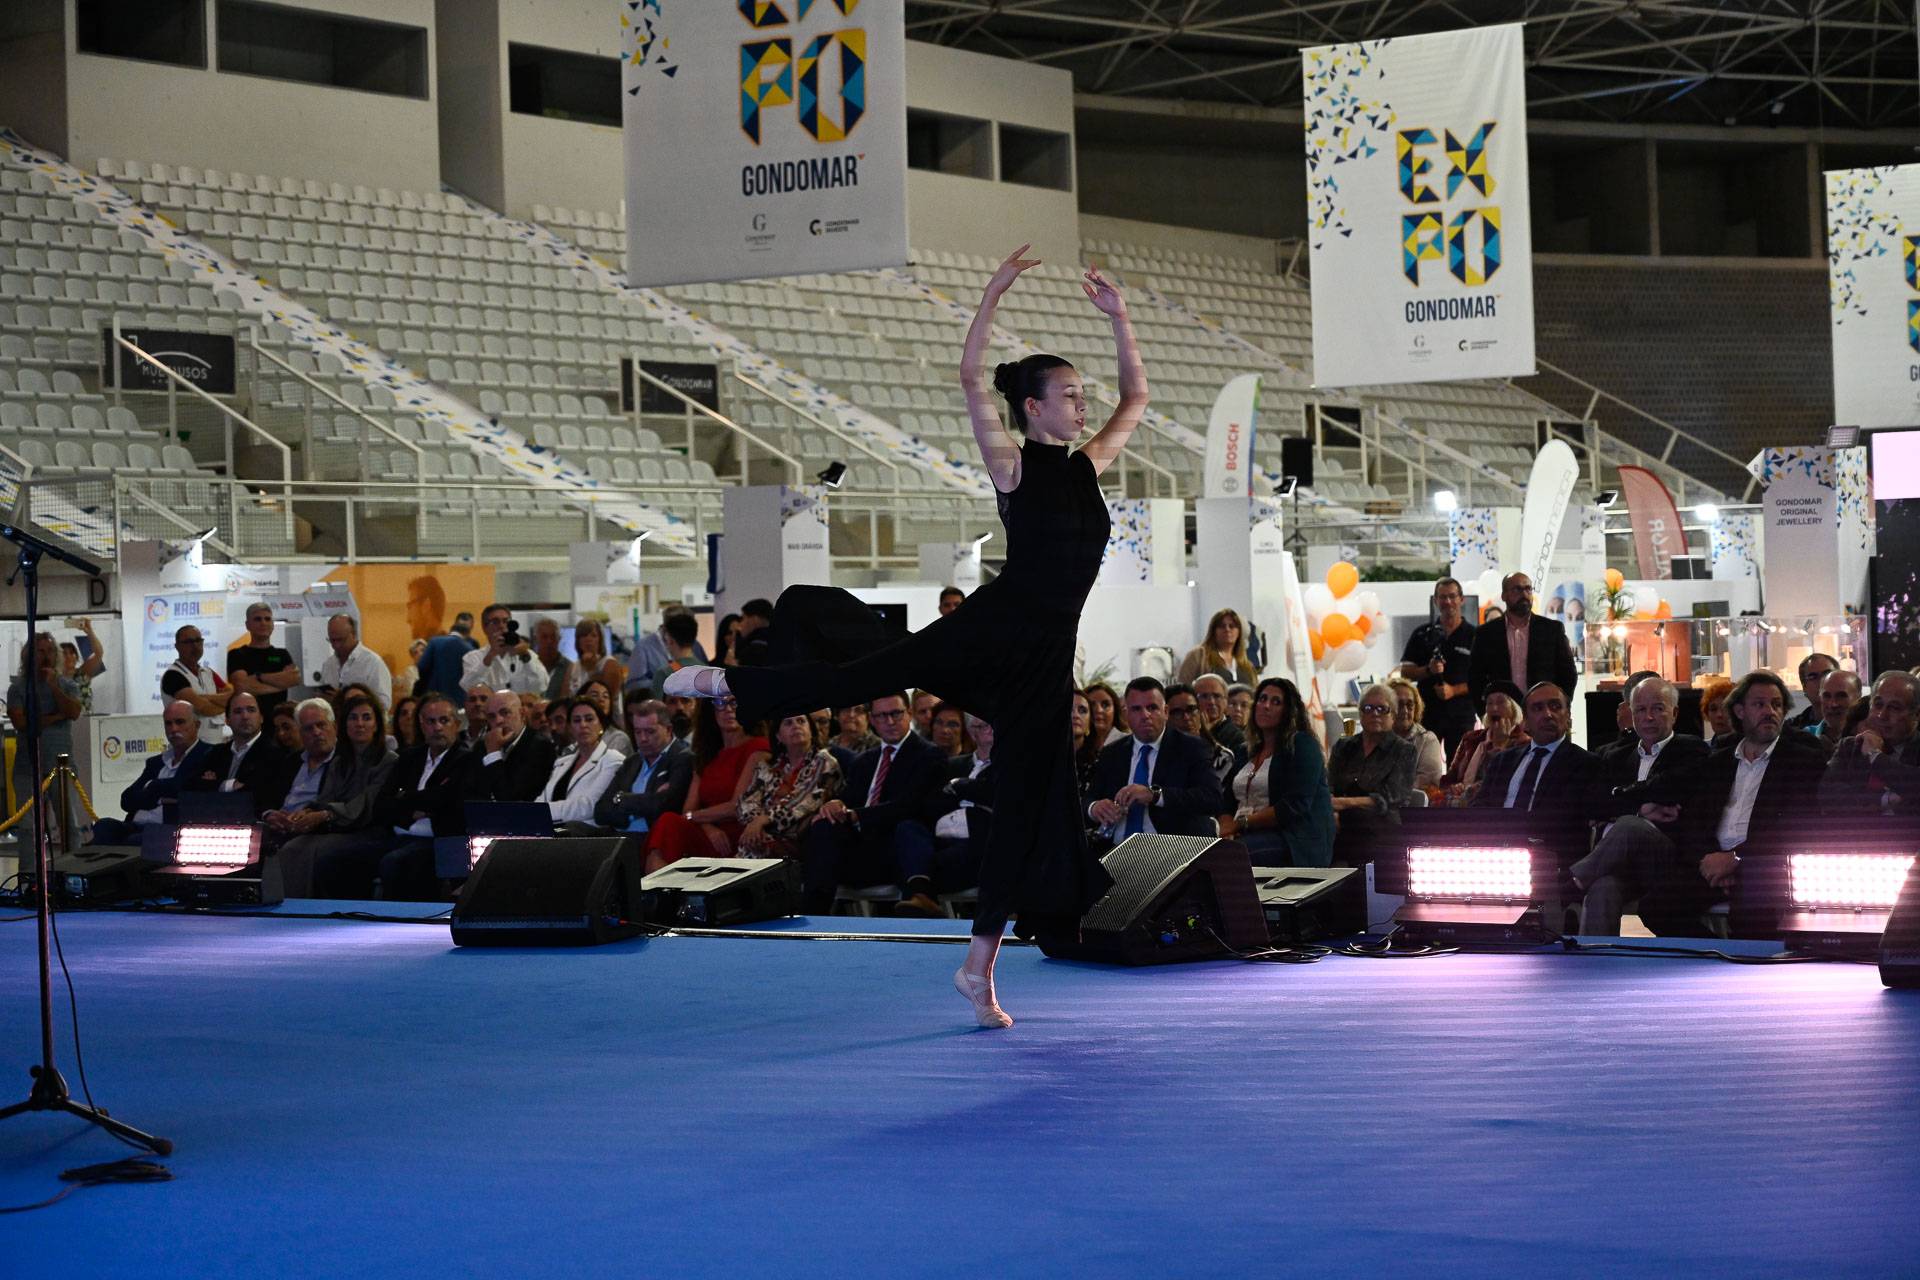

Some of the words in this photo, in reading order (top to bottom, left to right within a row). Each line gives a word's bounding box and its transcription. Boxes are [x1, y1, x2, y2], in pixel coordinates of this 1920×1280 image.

[742, 154, 859, 197] GONDOMAR
[1405, 295, 1496, 323] GONDOMAR
[1226, 423, 1239, 471] BOSCH
[1776, 497, 1823, 506] GONDOMAR
[1780, 508, 1818, 516] ORIGINAL
[1776, 517, 1823, 526] JEWELLERY
